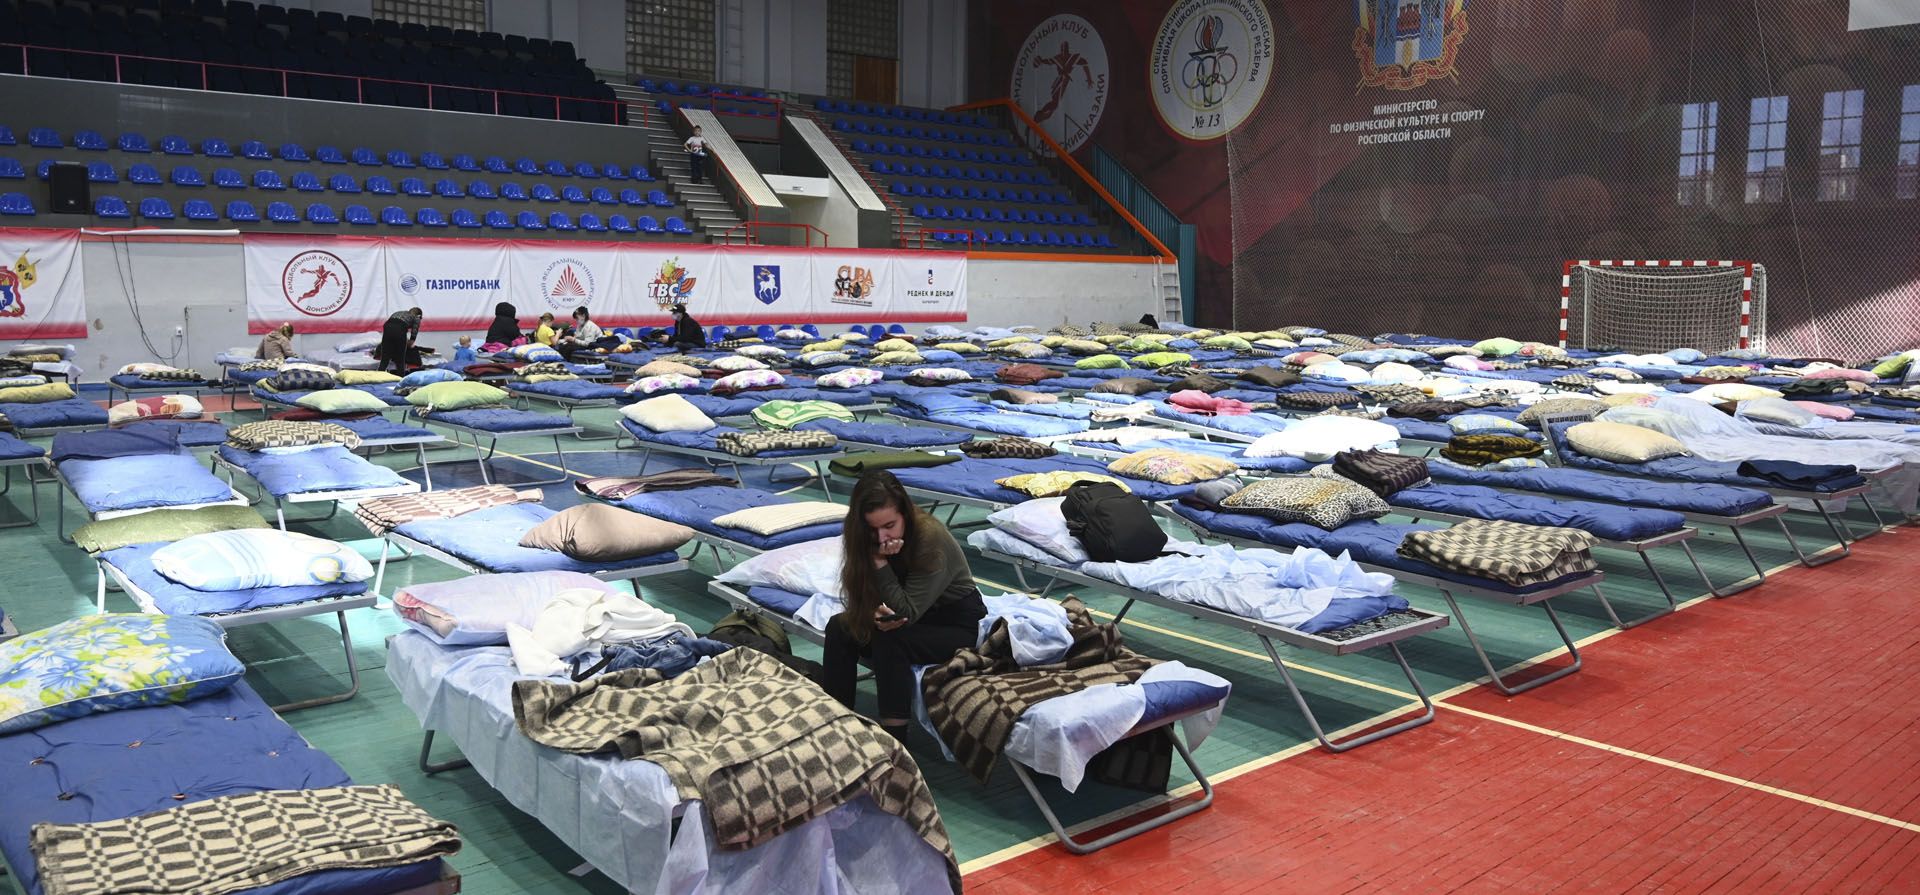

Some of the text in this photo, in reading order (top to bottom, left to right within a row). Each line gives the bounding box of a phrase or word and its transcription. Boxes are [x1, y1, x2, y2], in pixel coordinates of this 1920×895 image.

[1161, 29, 1178, 94] СПОРТИВНАЯ
[1175, 2, 1201, 28] ШКОЛА
[1248, 36, 1261, 82] РЕЗЕРВА
[1013, 20, 1089, 102] НДБОЛЬНЫЙ КЛУБ
[1083, 73, 1105, 131] КАЗАКИ
[1373, 100, 1437, 115] МИНИСТЕРСТВО
[1208, 113, 1221, 127] 13
[1330, 109, 1485, 133] ПО ФИЗИЧЕСКОЙ КУЛЬТУРЕ И СПОРТУ
[1358, 127, 1451, 145] РОСТОВСКОЙ ОБЛАСТИ
[287, 255, 337, 294] ГАНДБОЛЬНЫЙ КЛУБ
[426, 279, 501, 290] ГАЗПРОМБАНК
[306, 303, 337, 313] ДОНСКИЕ
